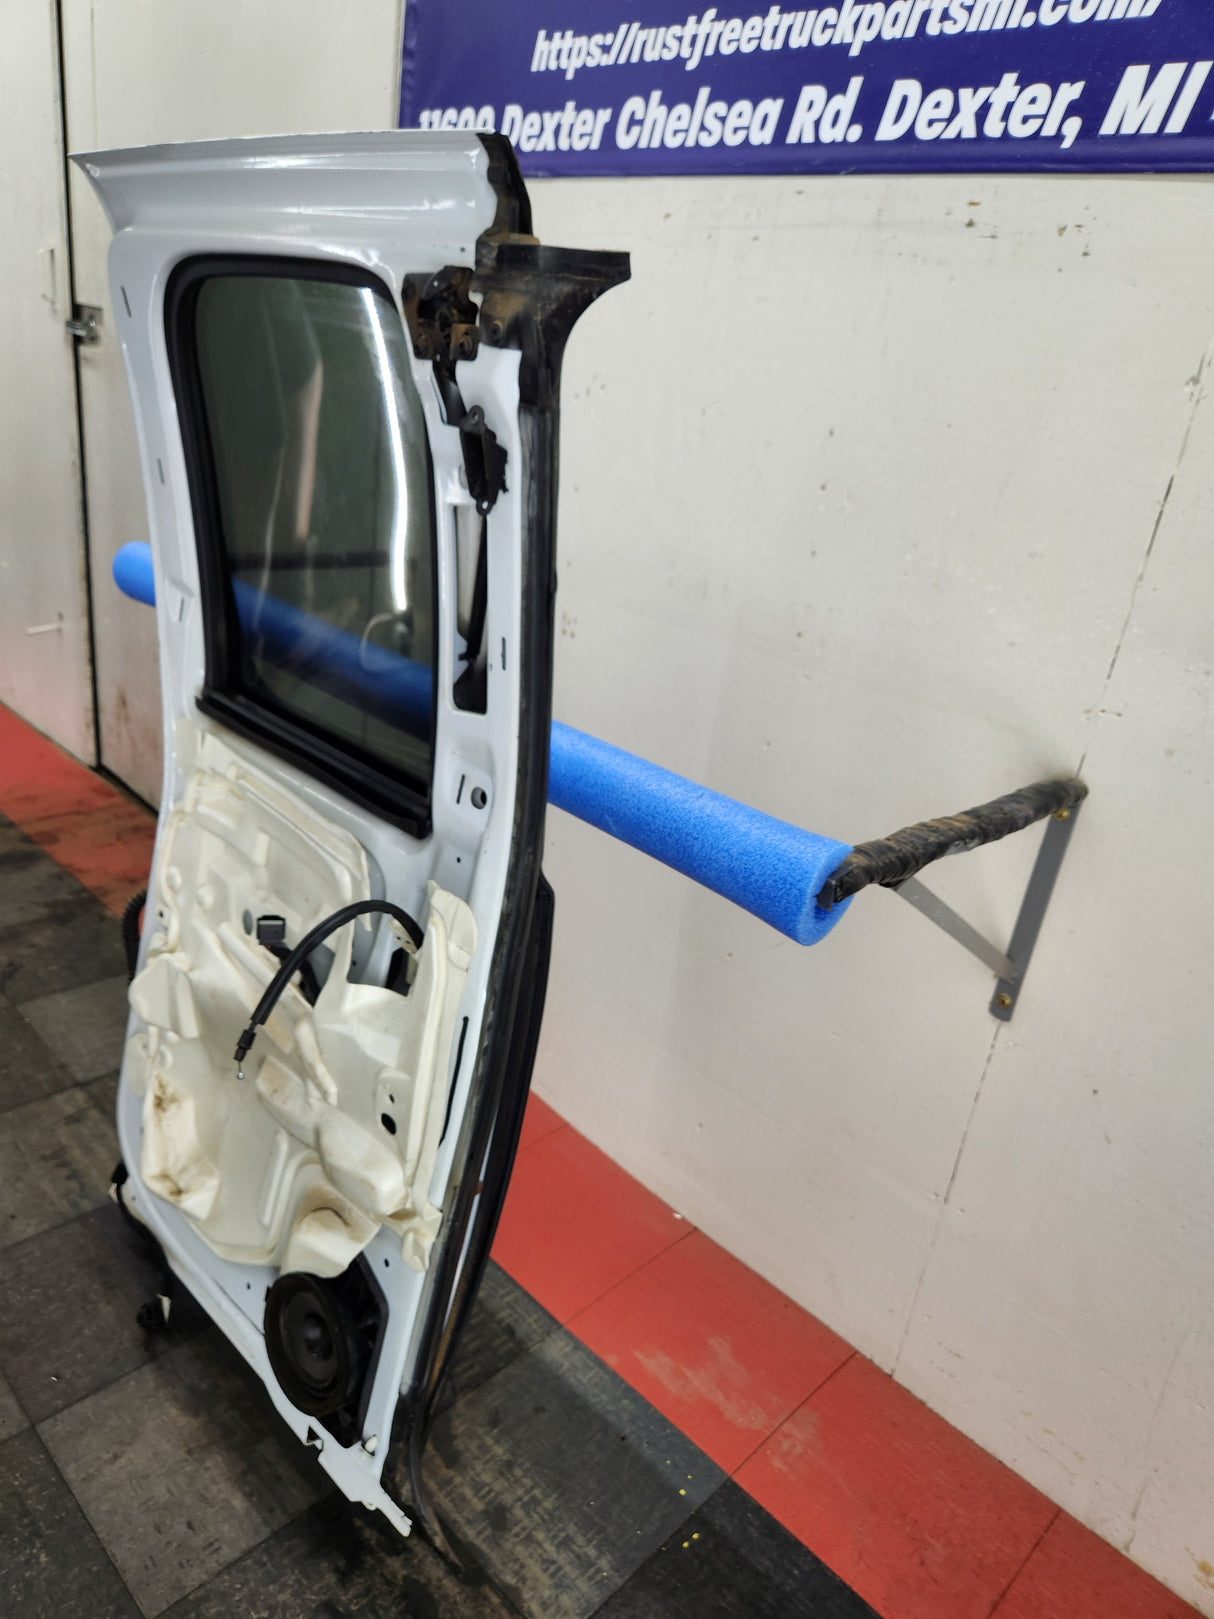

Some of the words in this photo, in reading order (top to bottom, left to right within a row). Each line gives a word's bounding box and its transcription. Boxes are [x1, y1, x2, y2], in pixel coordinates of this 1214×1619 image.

[500, 101, 612, 152] Dexter
[615, 86, 785, 150] Chelsea
[785, 76, 864, 144] Rd.
[874, 72, 1087, 149] Dexter,
[1097, 60, 1214, 135] MI
